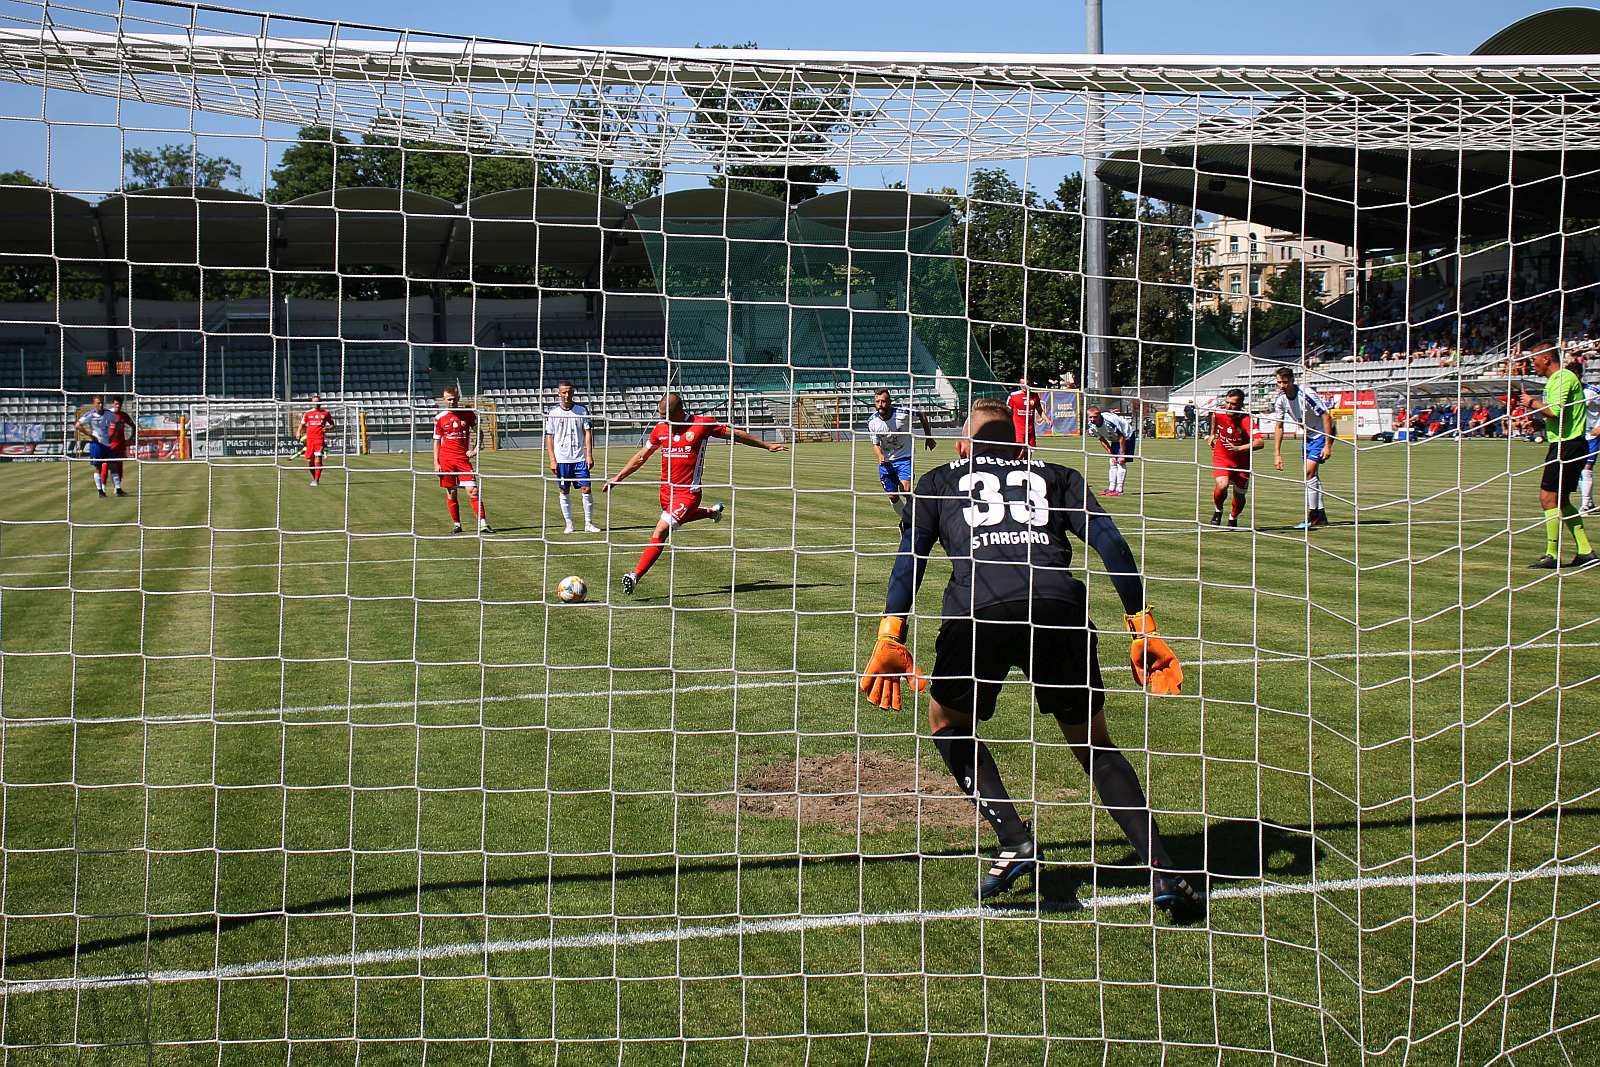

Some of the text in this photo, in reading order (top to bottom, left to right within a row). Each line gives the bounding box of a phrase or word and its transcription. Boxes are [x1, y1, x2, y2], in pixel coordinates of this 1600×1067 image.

[949, 458, 970, 470] KP
[958, 470, 1049, 527] 33
[972, 531, 1050, 550] STARGARD
